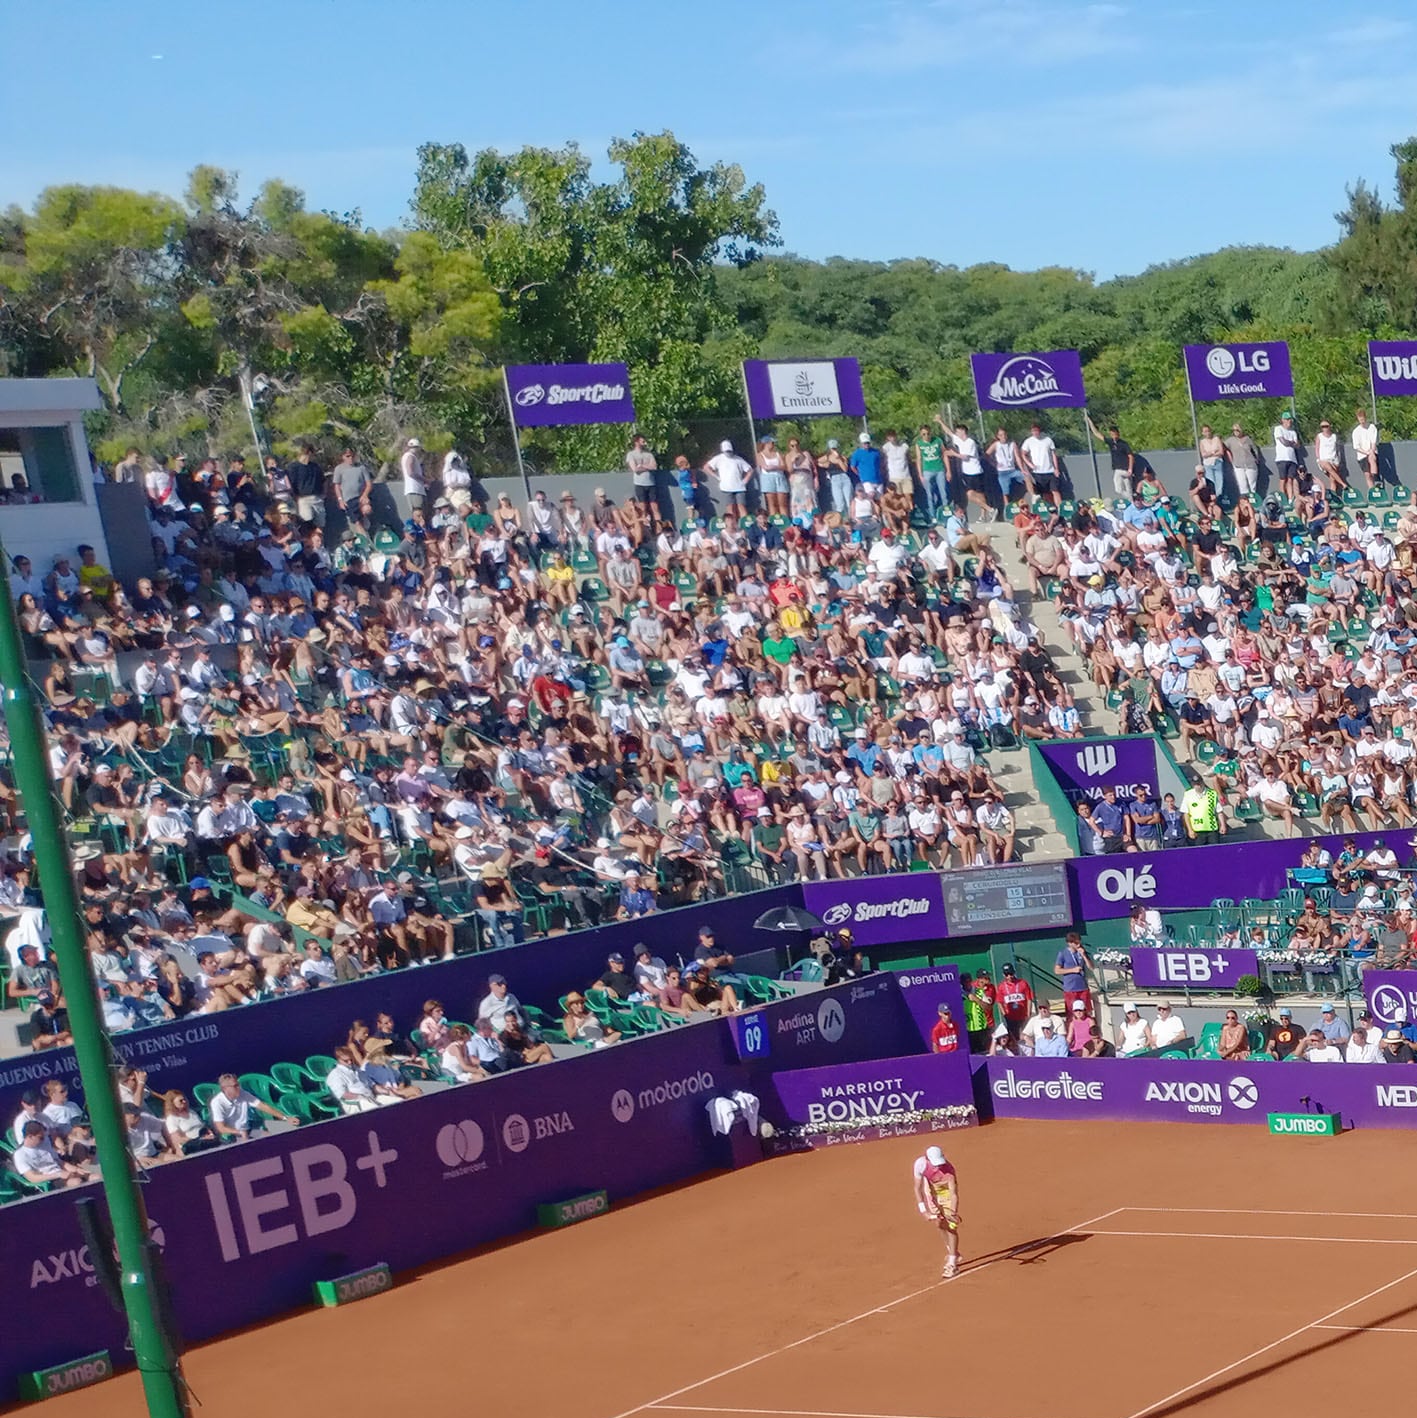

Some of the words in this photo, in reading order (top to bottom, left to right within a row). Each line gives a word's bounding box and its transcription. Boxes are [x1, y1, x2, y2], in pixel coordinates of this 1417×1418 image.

[1240, 351, 1270, 372] LG
[547, 384, 624, 406] SportClub
[1002, 373, 1058, 398] McCain
[781, 395, 833, 408] Emirates
[1097, 864, 1157, 902] Olé
[854, 898, 930, 921] SportClub
[911, 971, 954, 986] tennium
[1157, 953, 1229, 982] IEB+
[777, 1011, 815, 1034] Andina
[136, 1034, 184, 1057] TENNIS
[185, 1023, 220, 1043] CLUB
[745, 1027, 762, 1052] 09
[796, 1028, 817, 1045] ART
[638, 1069, 715, 1110] motorola
[821, 1078, 903, 1098] MARRIOTT
[1145, 1082, 1222, 1102] AXION
[808, 1091, 919, 1124] BONVOY
[1188, 1103, 1222, 1116] energy
[534, 1111, 575, 1140] BNA
[879, 1128, 892, 1138] Bio
[895, 1125, 917, 1136] Verde
[931, 1121, 945, 1131] Bio
[947, 1118, 970, 1129] Verde
[1274, 1117, 1327, 1132] JUMBO
[826, 1135, 841, 1145] Bio
[843, 1132, 865, 1144] Verde
[204, 1130, 399, 1263] IEB+
[561, 1195, 604, 1220] JUMBO
[30, 1244, 96, 1289] AXIO
[339, 1271, 387, 1300] JUMBO
[47, 1358, 106, 1392] JUMBO
